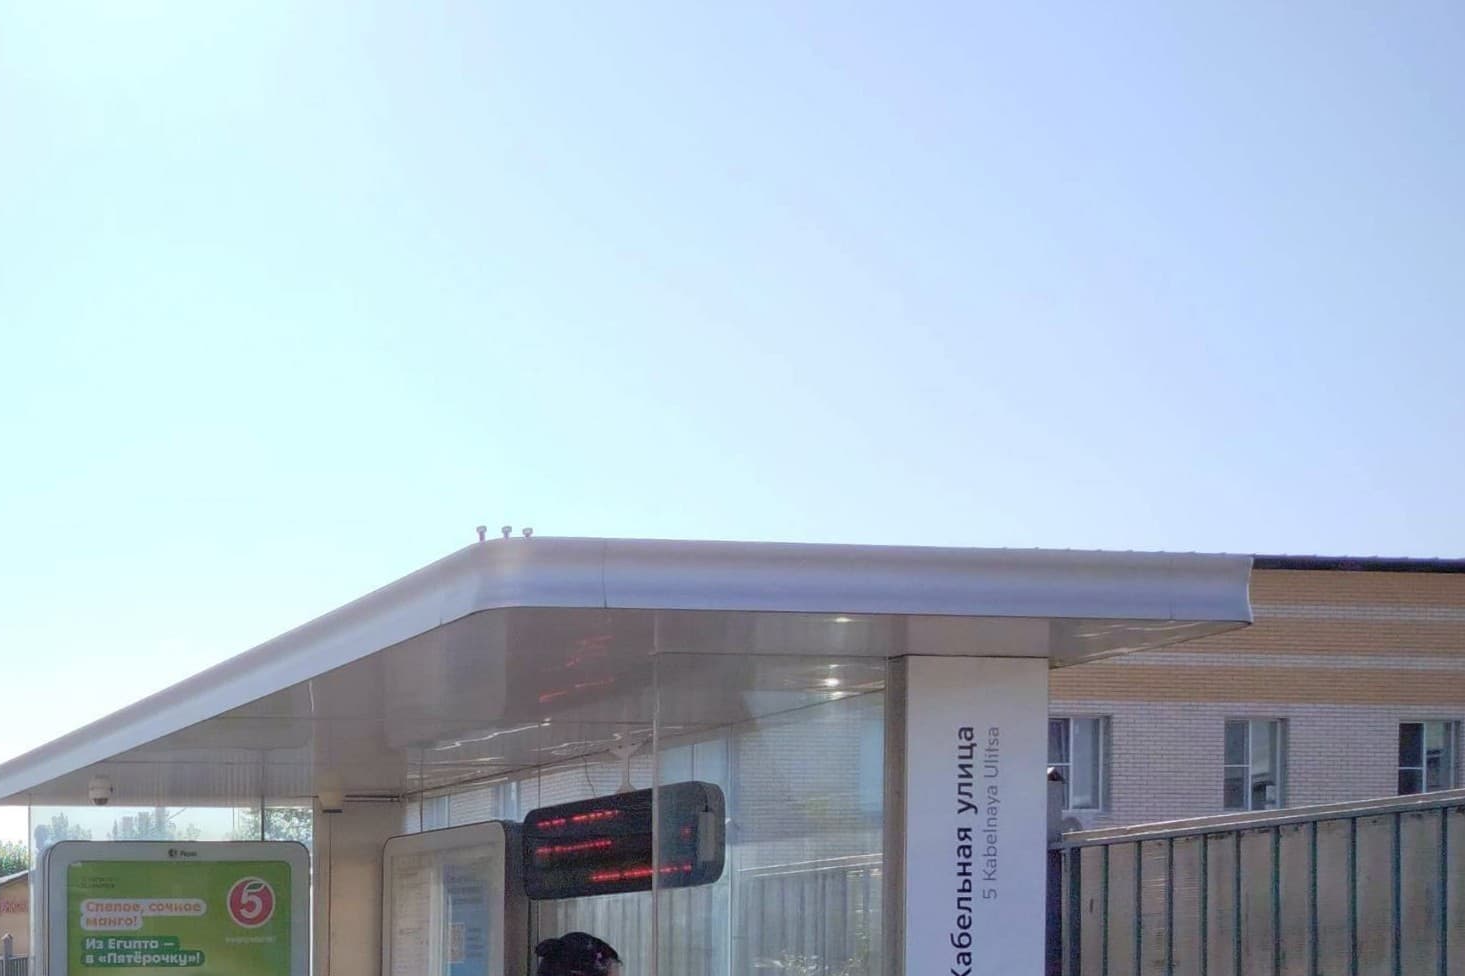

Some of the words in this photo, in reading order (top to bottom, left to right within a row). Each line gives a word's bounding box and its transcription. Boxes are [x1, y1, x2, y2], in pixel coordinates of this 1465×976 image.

[956, 725, 978, 815] улица
[983, 726, 1000, 779] Ulitsa
[982, 784, 1001, 881] Kabelnaya
[239, 879, 265, 919] 5
[982, 888, 998, 900] 5
[85, 938, 104, 950] Из
[108, 938, 159, 950] Египта
[85, 954, 94, 964] в
